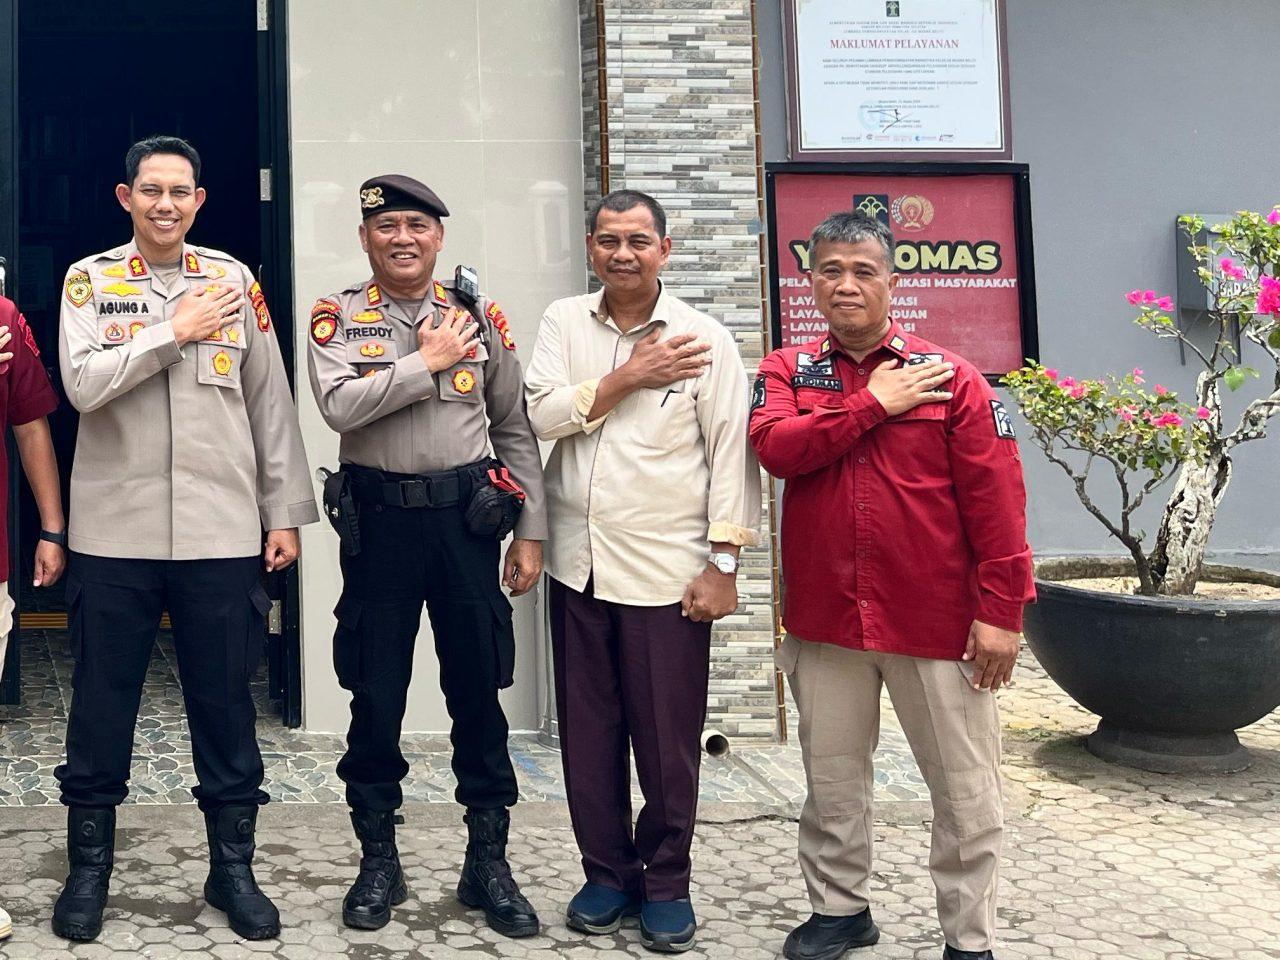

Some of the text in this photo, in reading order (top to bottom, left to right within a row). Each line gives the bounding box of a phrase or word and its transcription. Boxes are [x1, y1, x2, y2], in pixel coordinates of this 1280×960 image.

[830, 39, 959, 49] MAKLUMAT PELAYANAN
[934, 278, 1017, 288] MASYARAKAT
[99, 302, 149, 315] AGUNG A
[345, 326, 393, 340] FREDDY
